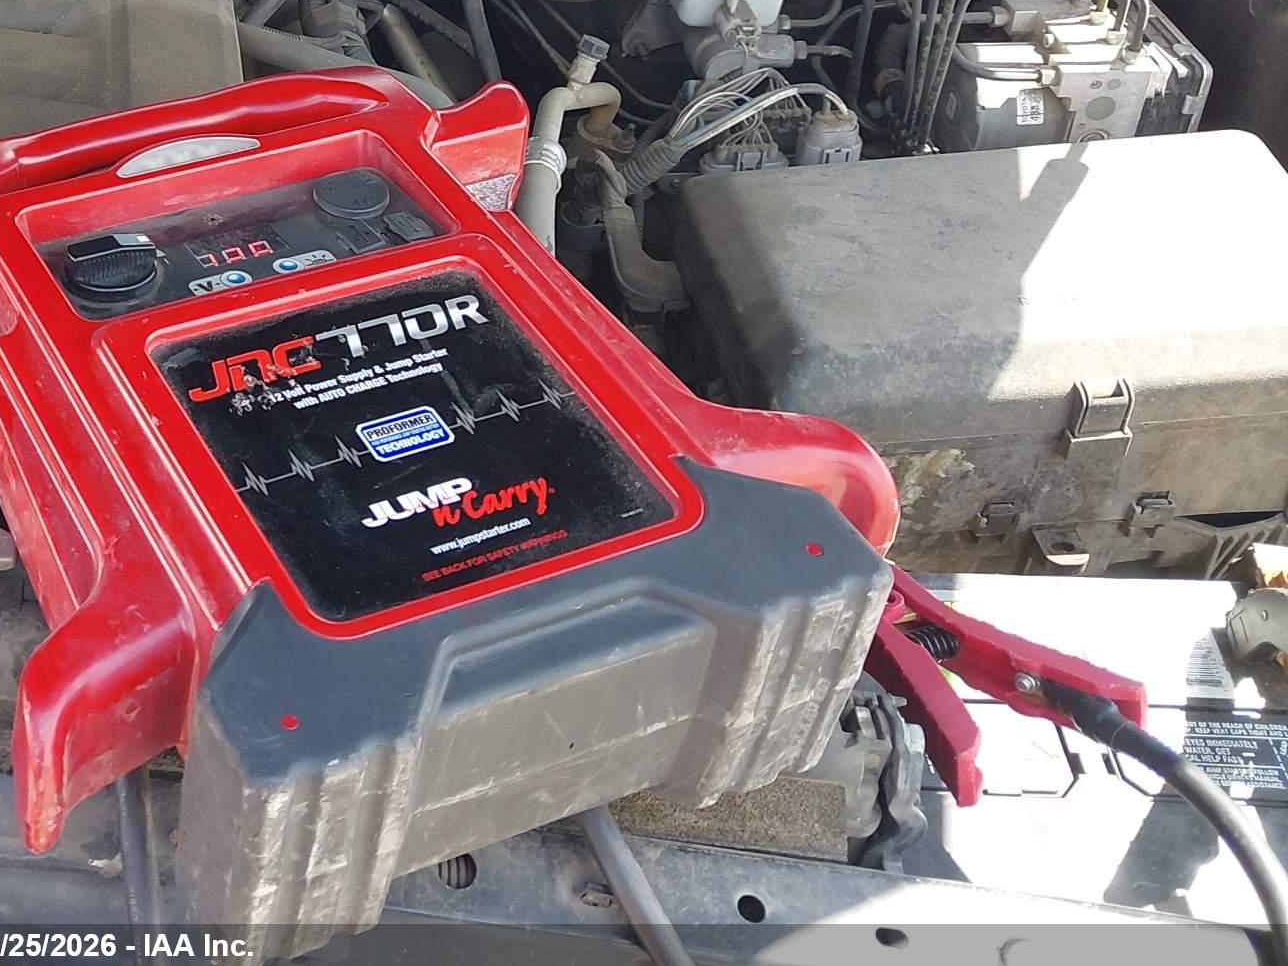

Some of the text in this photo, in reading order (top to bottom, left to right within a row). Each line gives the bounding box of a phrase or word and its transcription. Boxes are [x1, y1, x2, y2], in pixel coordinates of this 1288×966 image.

[283, 385, 305, 400] Volt
[305, 378, 338, 394] Power
[337, 368, 374, 385] Supply
[373, 365, 385, 375] &
[385, 358, 414, 372] Jump
[412, 348, 449, 365] Starter
[293, 362, 444, 410] with AUTO CHARGE Technology
[366, 414, 433, 440] PROFORMER
[375, 428, 446, 455] TECHNOLOGY
[361, 477, 473, 528] JUMP
[430, 517, 532, 555] www.jumpstarter.com
[422, 569, 442, 582] SEE
[441, 560, 468, 577] BACK
[467, 554, 488, 568] FOR
[487, 544, 520, 562] SAFETY
